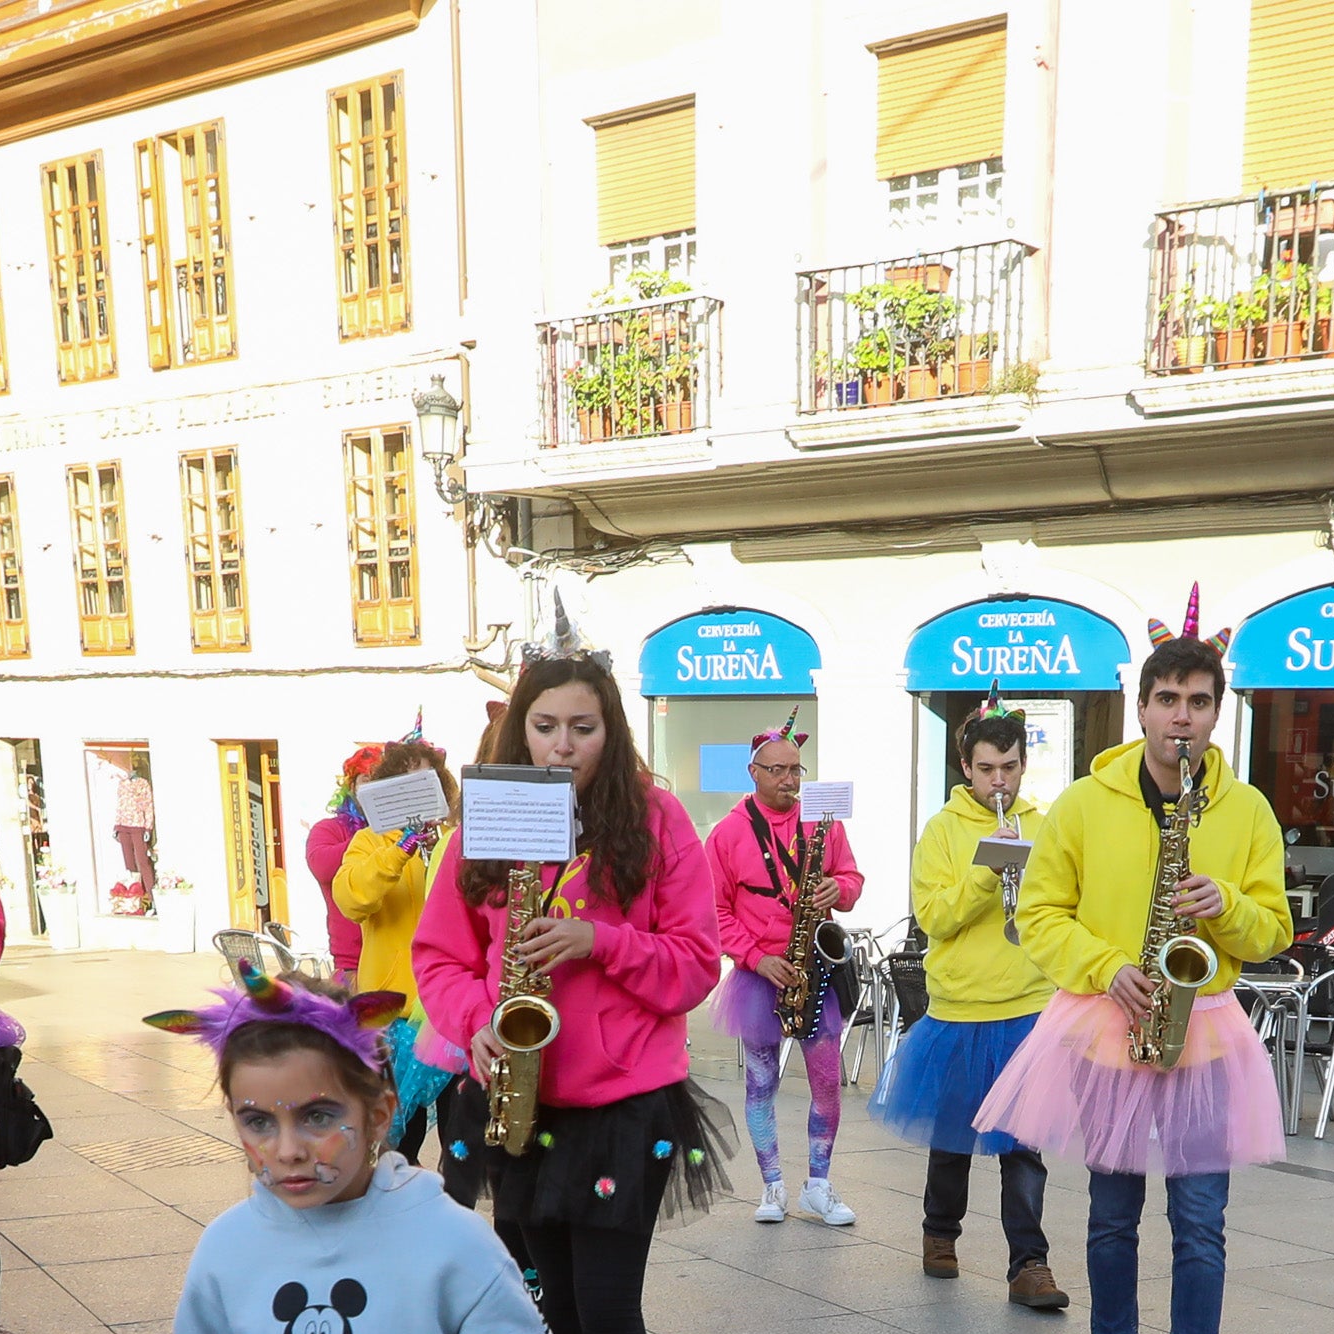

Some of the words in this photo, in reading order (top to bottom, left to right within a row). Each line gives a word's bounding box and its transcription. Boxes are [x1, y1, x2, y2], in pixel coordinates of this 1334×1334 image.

[697, 621, 761, 638] CERVECERÍA
[978, 609, 1056, 628] CERVECERÍA
[723, 640, 736, 652] LA
[1008, 630, 1024, 644] LA
[676, 643, 783, 682] SUREÑA
[951, 633, 1081, 676] SUREÑA
[231, 783, 245, 880] PELUQUERIA
[249, 802, 264, 896] PELUQUERIA
